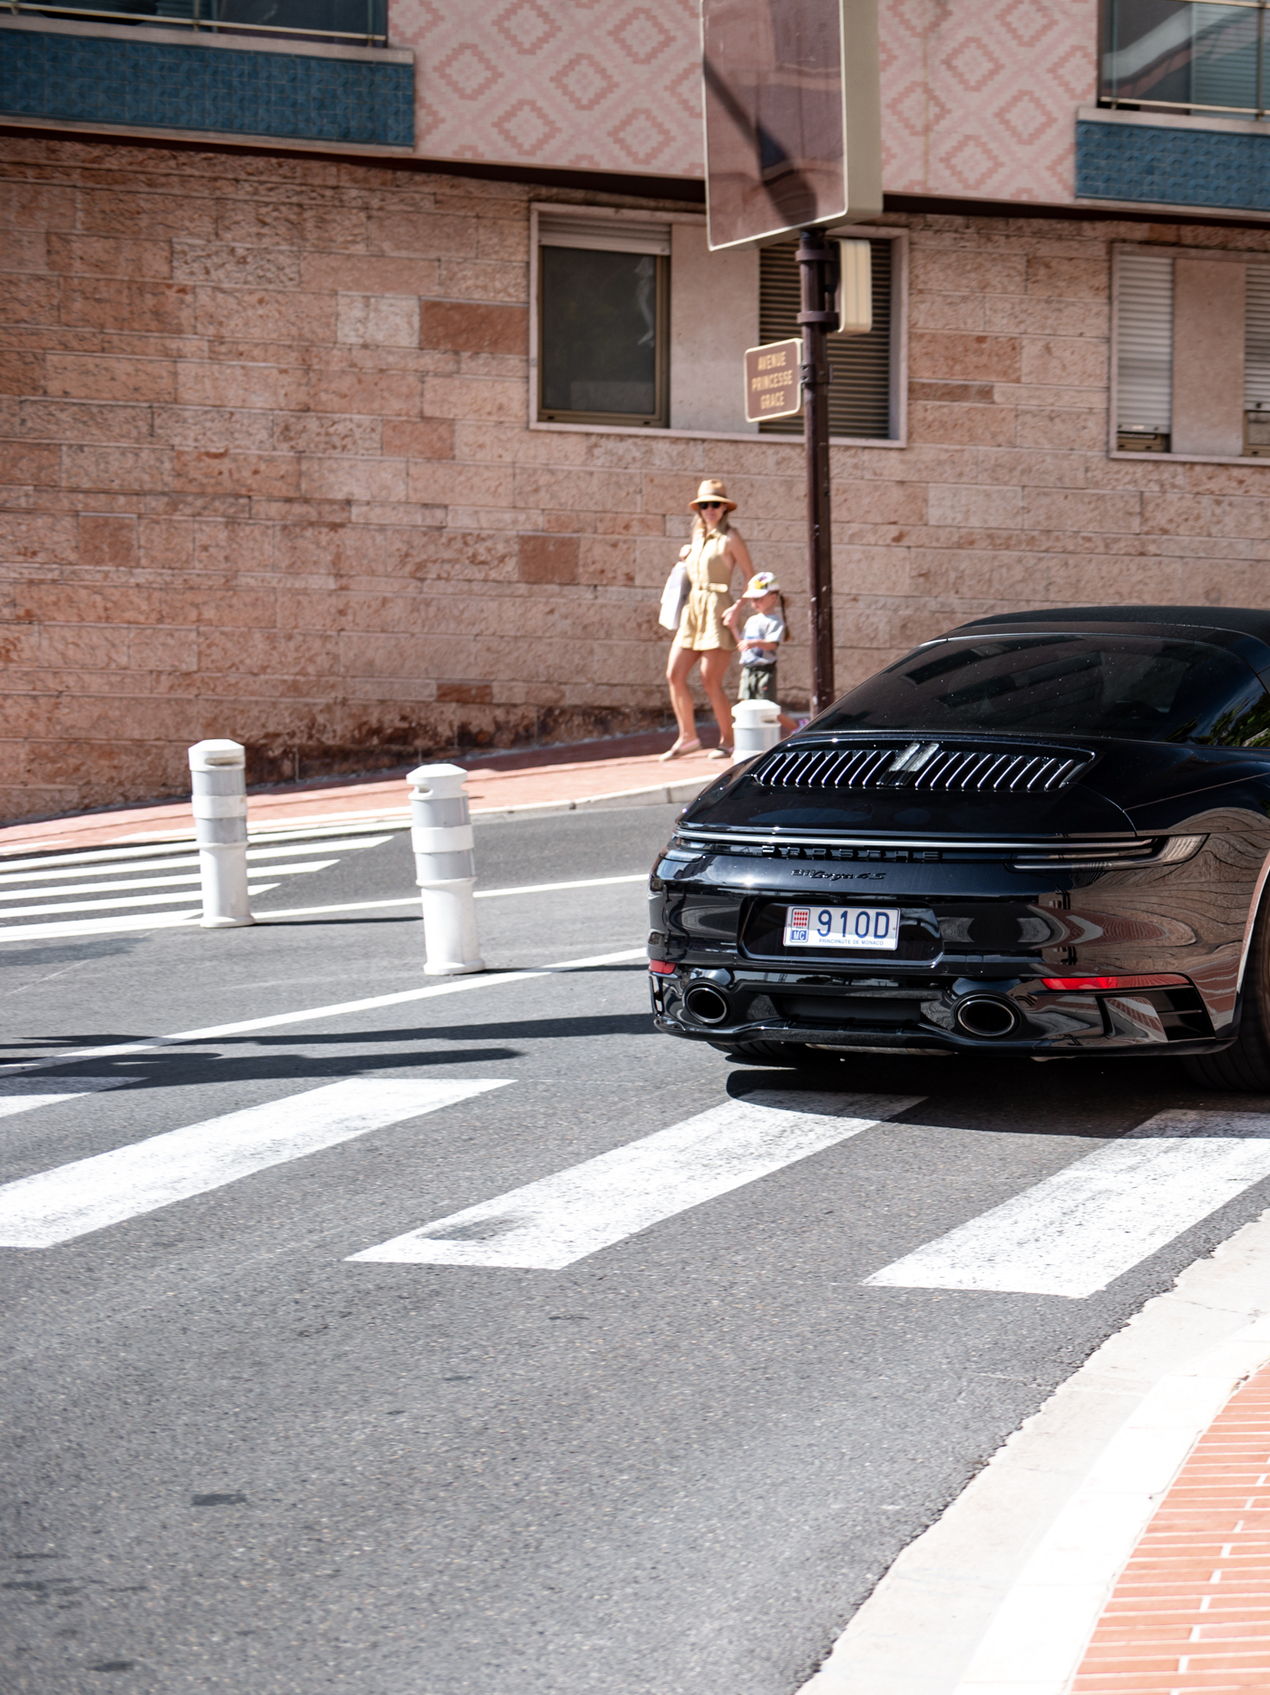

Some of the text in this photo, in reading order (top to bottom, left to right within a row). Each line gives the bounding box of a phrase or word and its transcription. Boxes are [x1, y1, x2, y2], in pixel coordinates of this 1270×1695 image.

[752, 370, 793, 393] PRINCESSE
[762, 845, 940, 862] PORSCHE
[817, 909, 890, 939] 910D
[793, 930, 806, 940] MC
